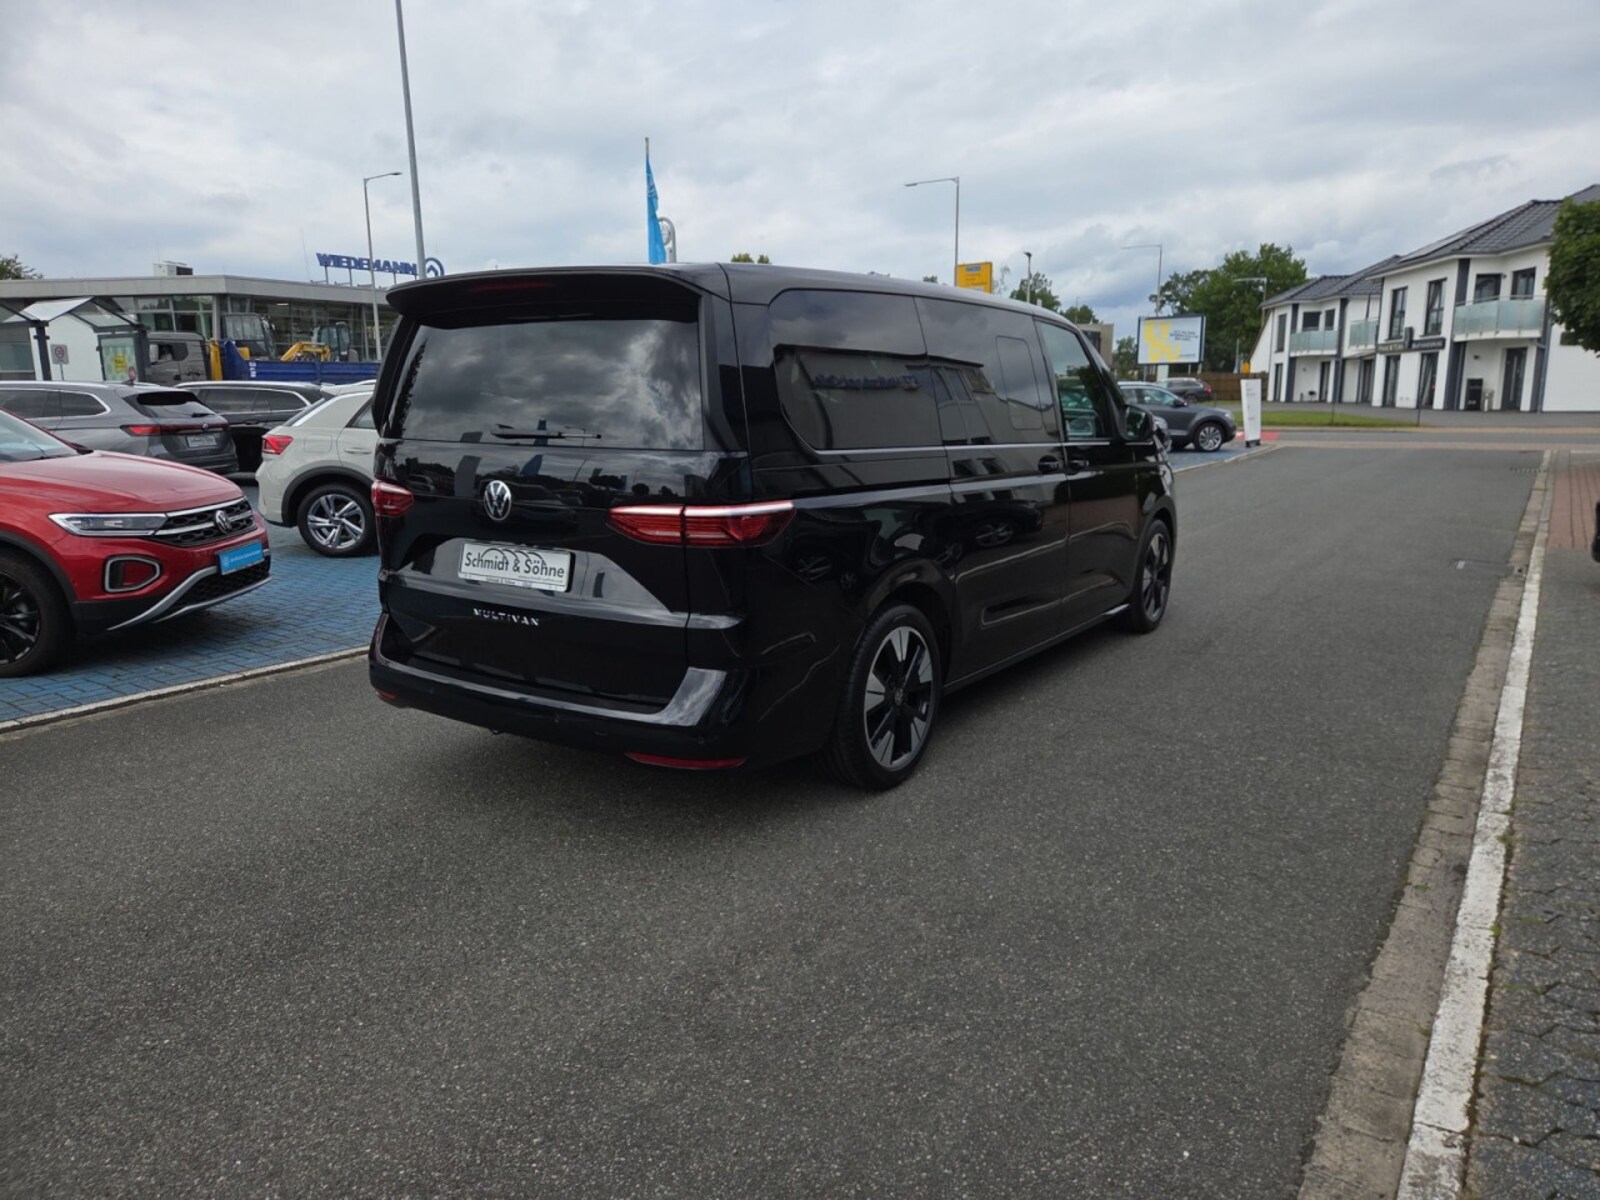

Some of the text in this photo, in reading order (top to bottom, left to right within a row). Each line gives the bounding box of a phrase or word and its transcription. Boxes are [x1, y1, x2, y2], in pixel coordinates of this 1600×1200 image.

[316, 253, 417, 275] WIEDEMANN
[464, 551, 565, 578] Schmidt & Söhne
